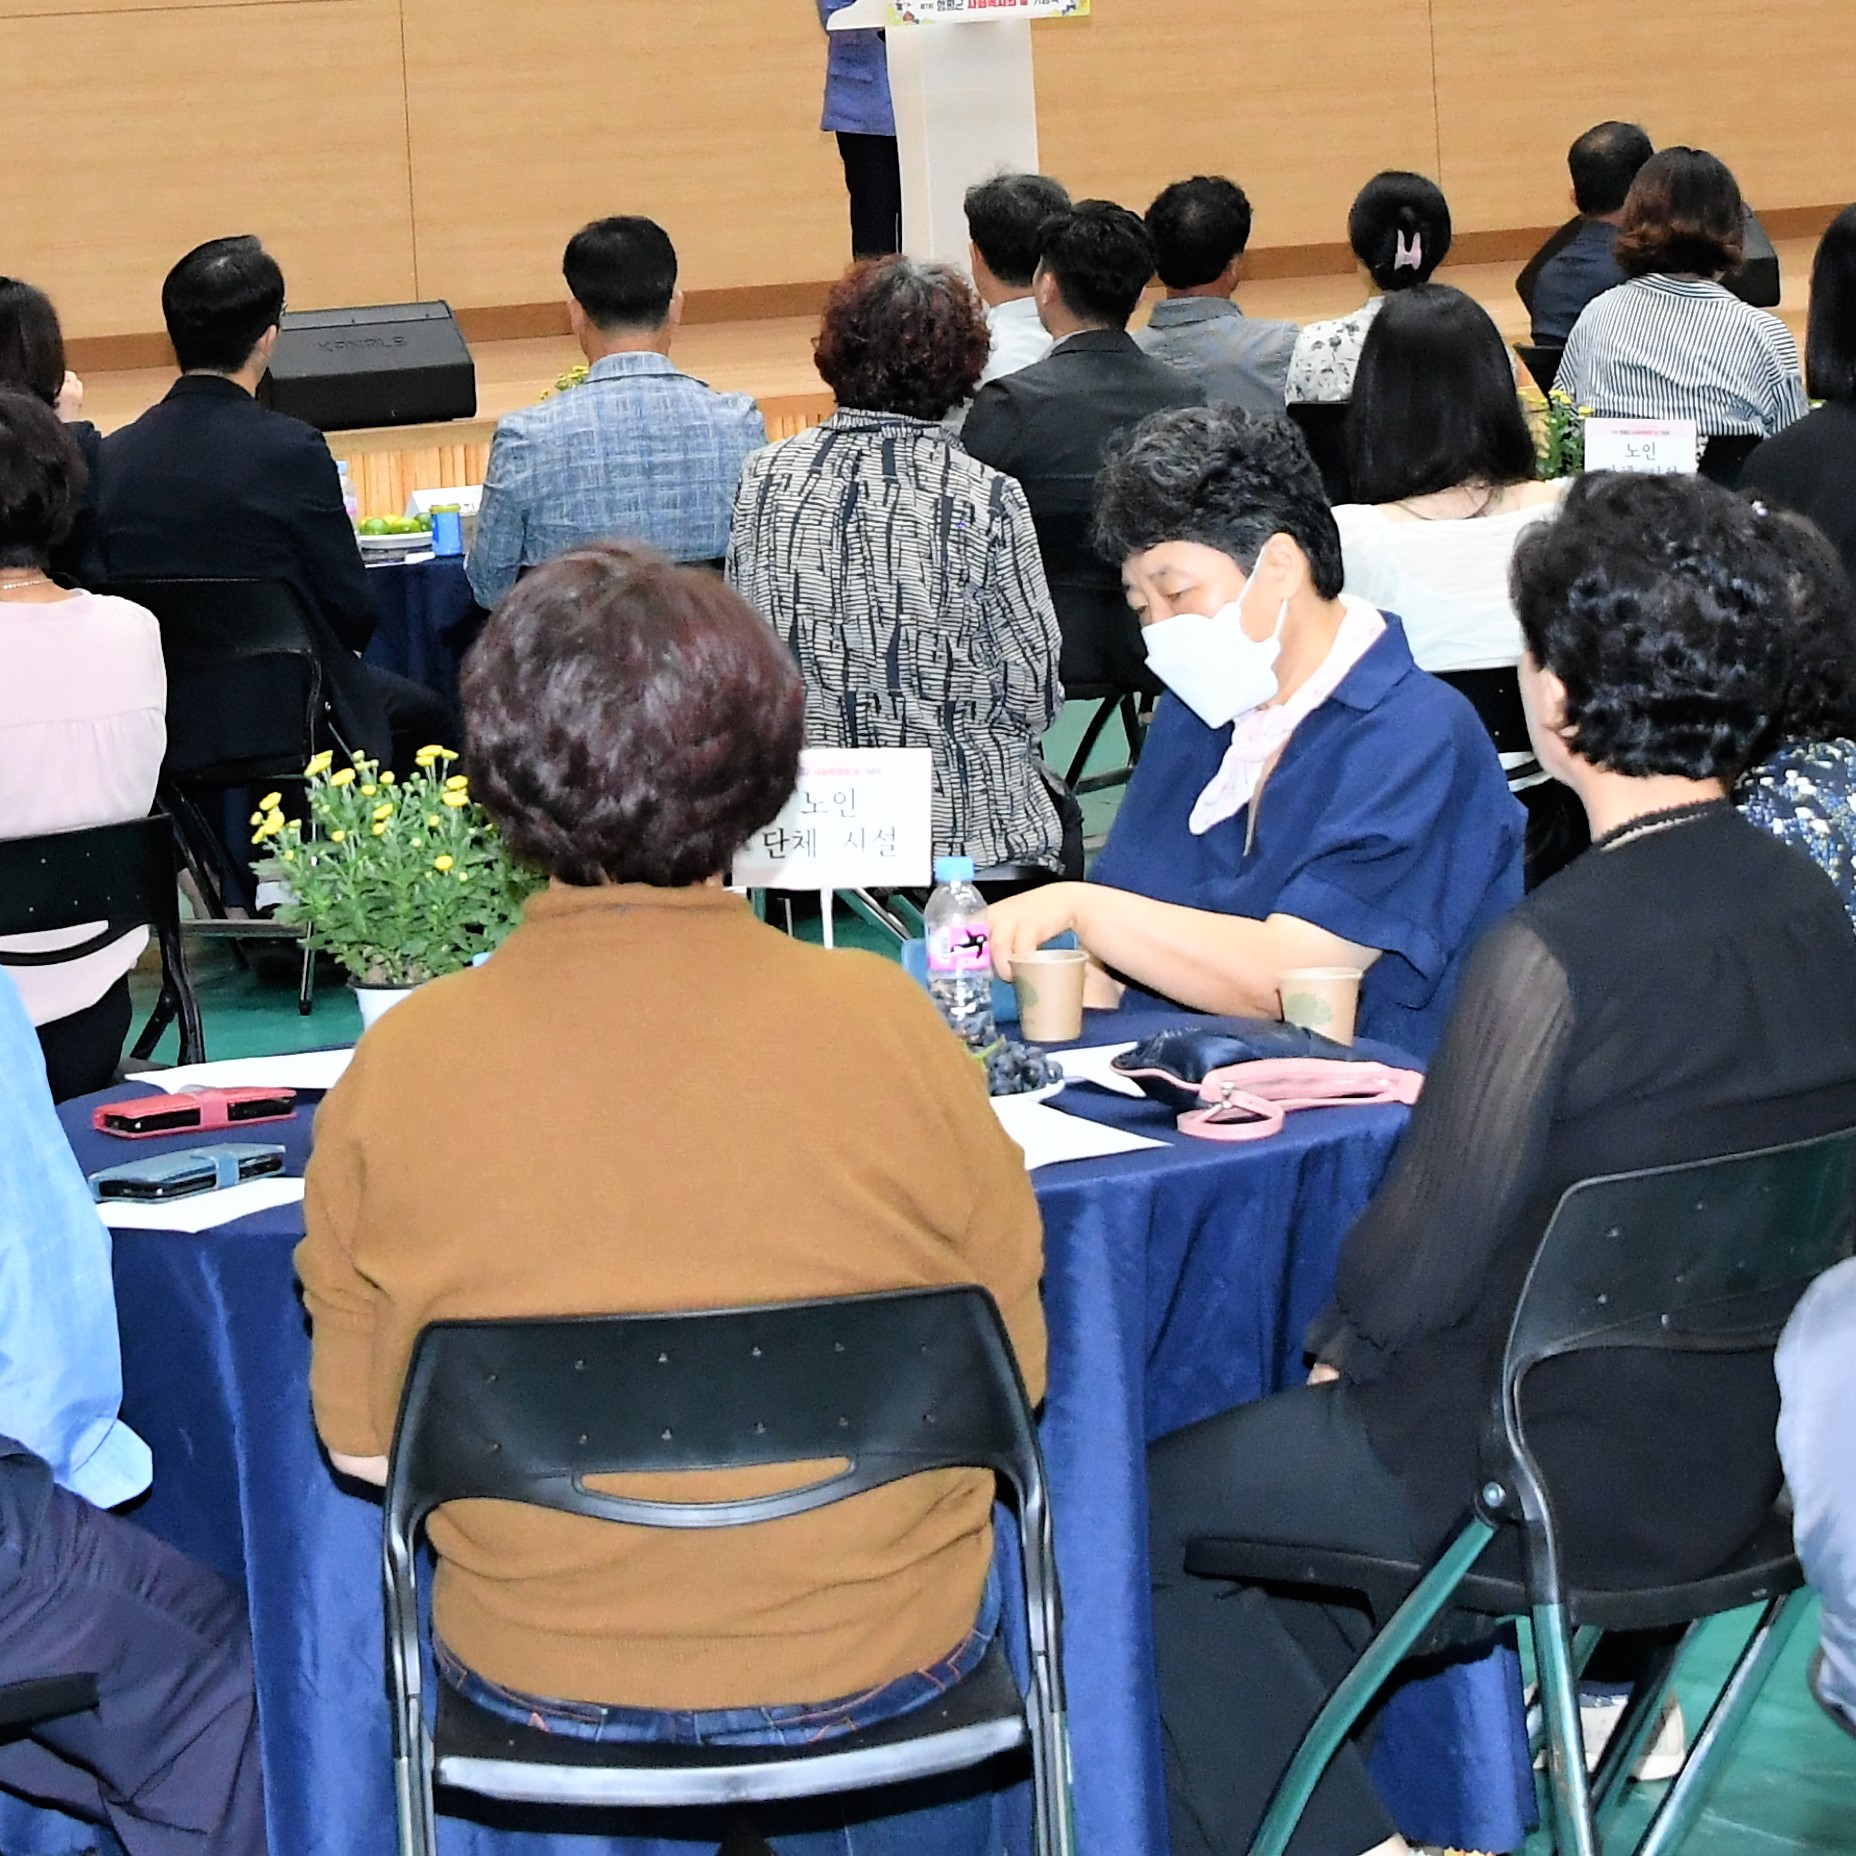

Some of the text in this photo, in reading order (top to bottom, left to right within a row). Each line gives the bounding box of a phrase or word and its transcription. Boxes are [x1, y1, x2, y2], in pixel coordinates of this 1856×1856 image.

[1625, 442, 1656, 461] 노인
[801, 788, 856, 818] 노인
[762, 827, 816, 859] 단체
